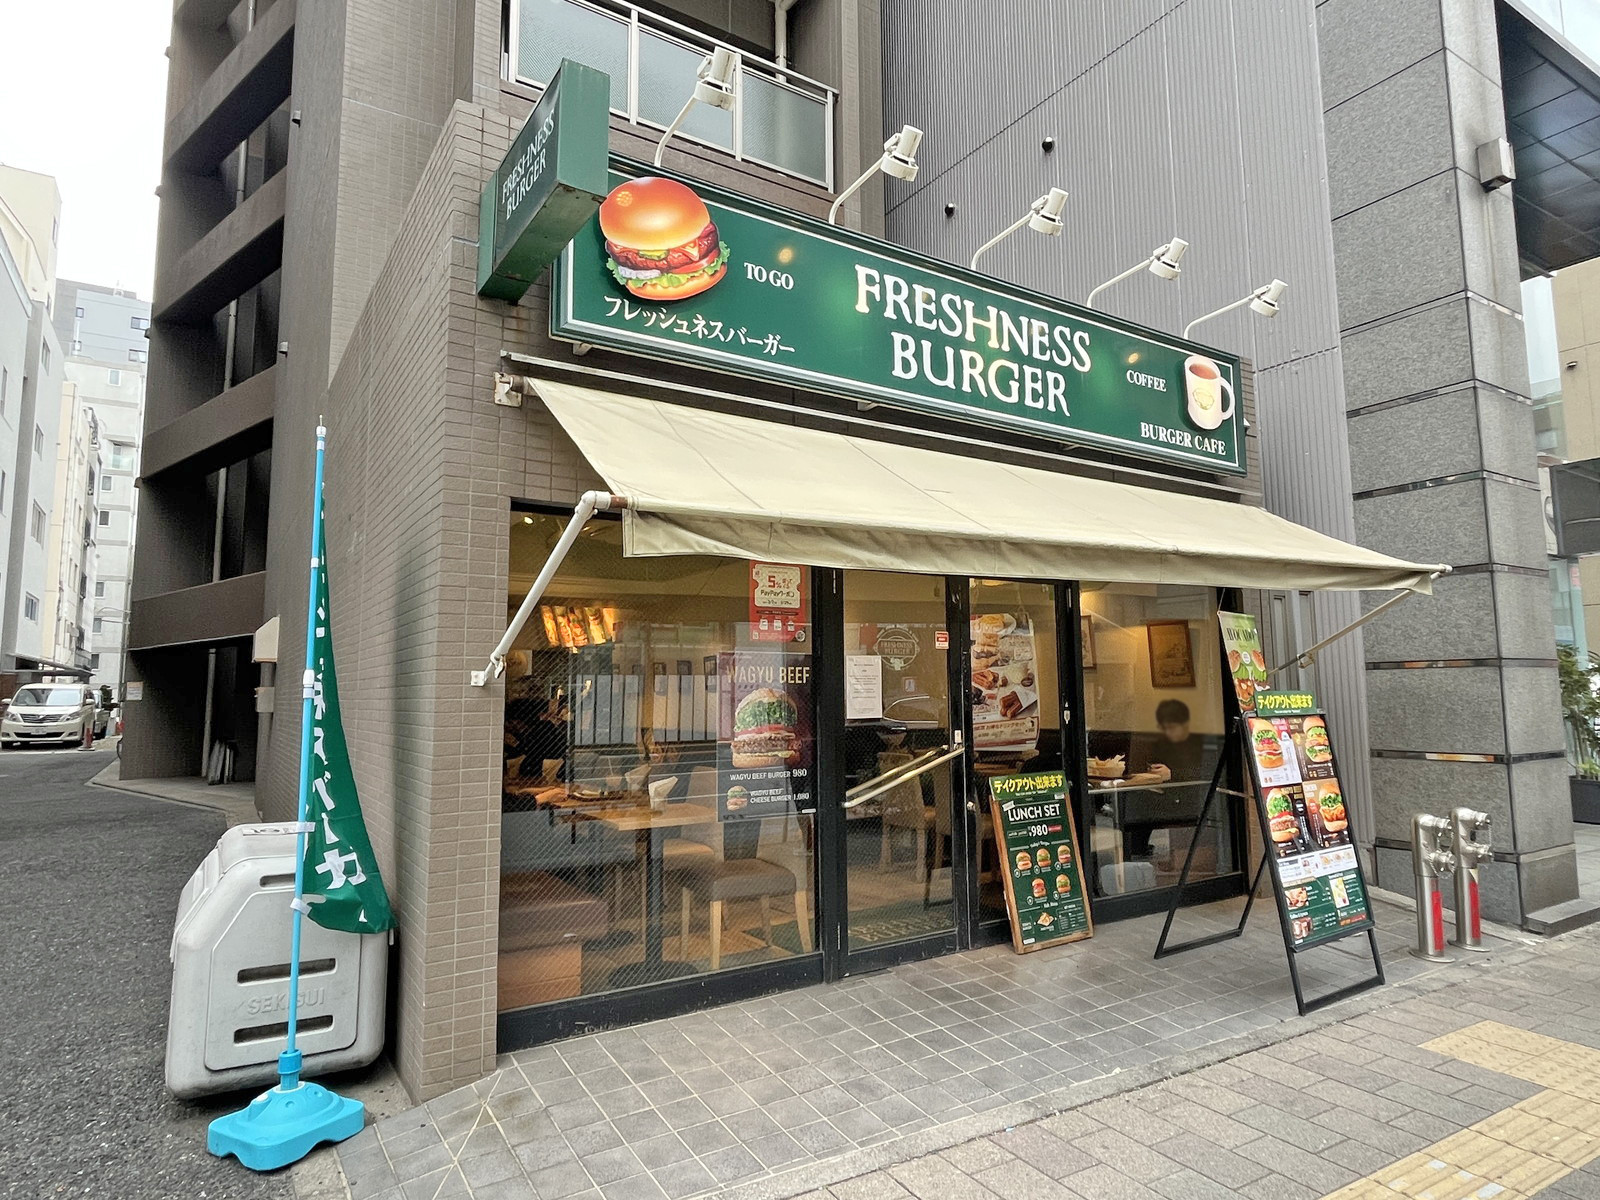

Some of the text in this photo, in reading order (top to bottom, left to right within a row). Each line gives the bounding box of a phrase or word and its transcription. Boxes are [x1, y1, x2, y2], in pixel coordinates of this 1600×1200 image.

[502, 108, 555, 205] FRESHNESS
[506, 148, 546, 220] BURGER
[743, 262, 795, 290] TO GO
[604, 295, 796, 356] フレッシュネスバーガー
[854, 263, 1092, 374] FRESHNESS
[891, 330, 1071, 417] BURGER
[1126, 369, 1167, 393] COFFEE
[1140, 421, 1226, 456] BURGER CAFE
[726, 665, 810, 684] WAGYU BEEF
[767, 770, 791, 779] BURGER
[792, 768, 807, 777] 980
[994, 774, 1063, 793] テイクアウト出来ます
[770, 794, 792, 802] BURGER
[1007, 803, 1060, 821] LUNCH SET
[247, 987, 325, 1015] SEKSUI
